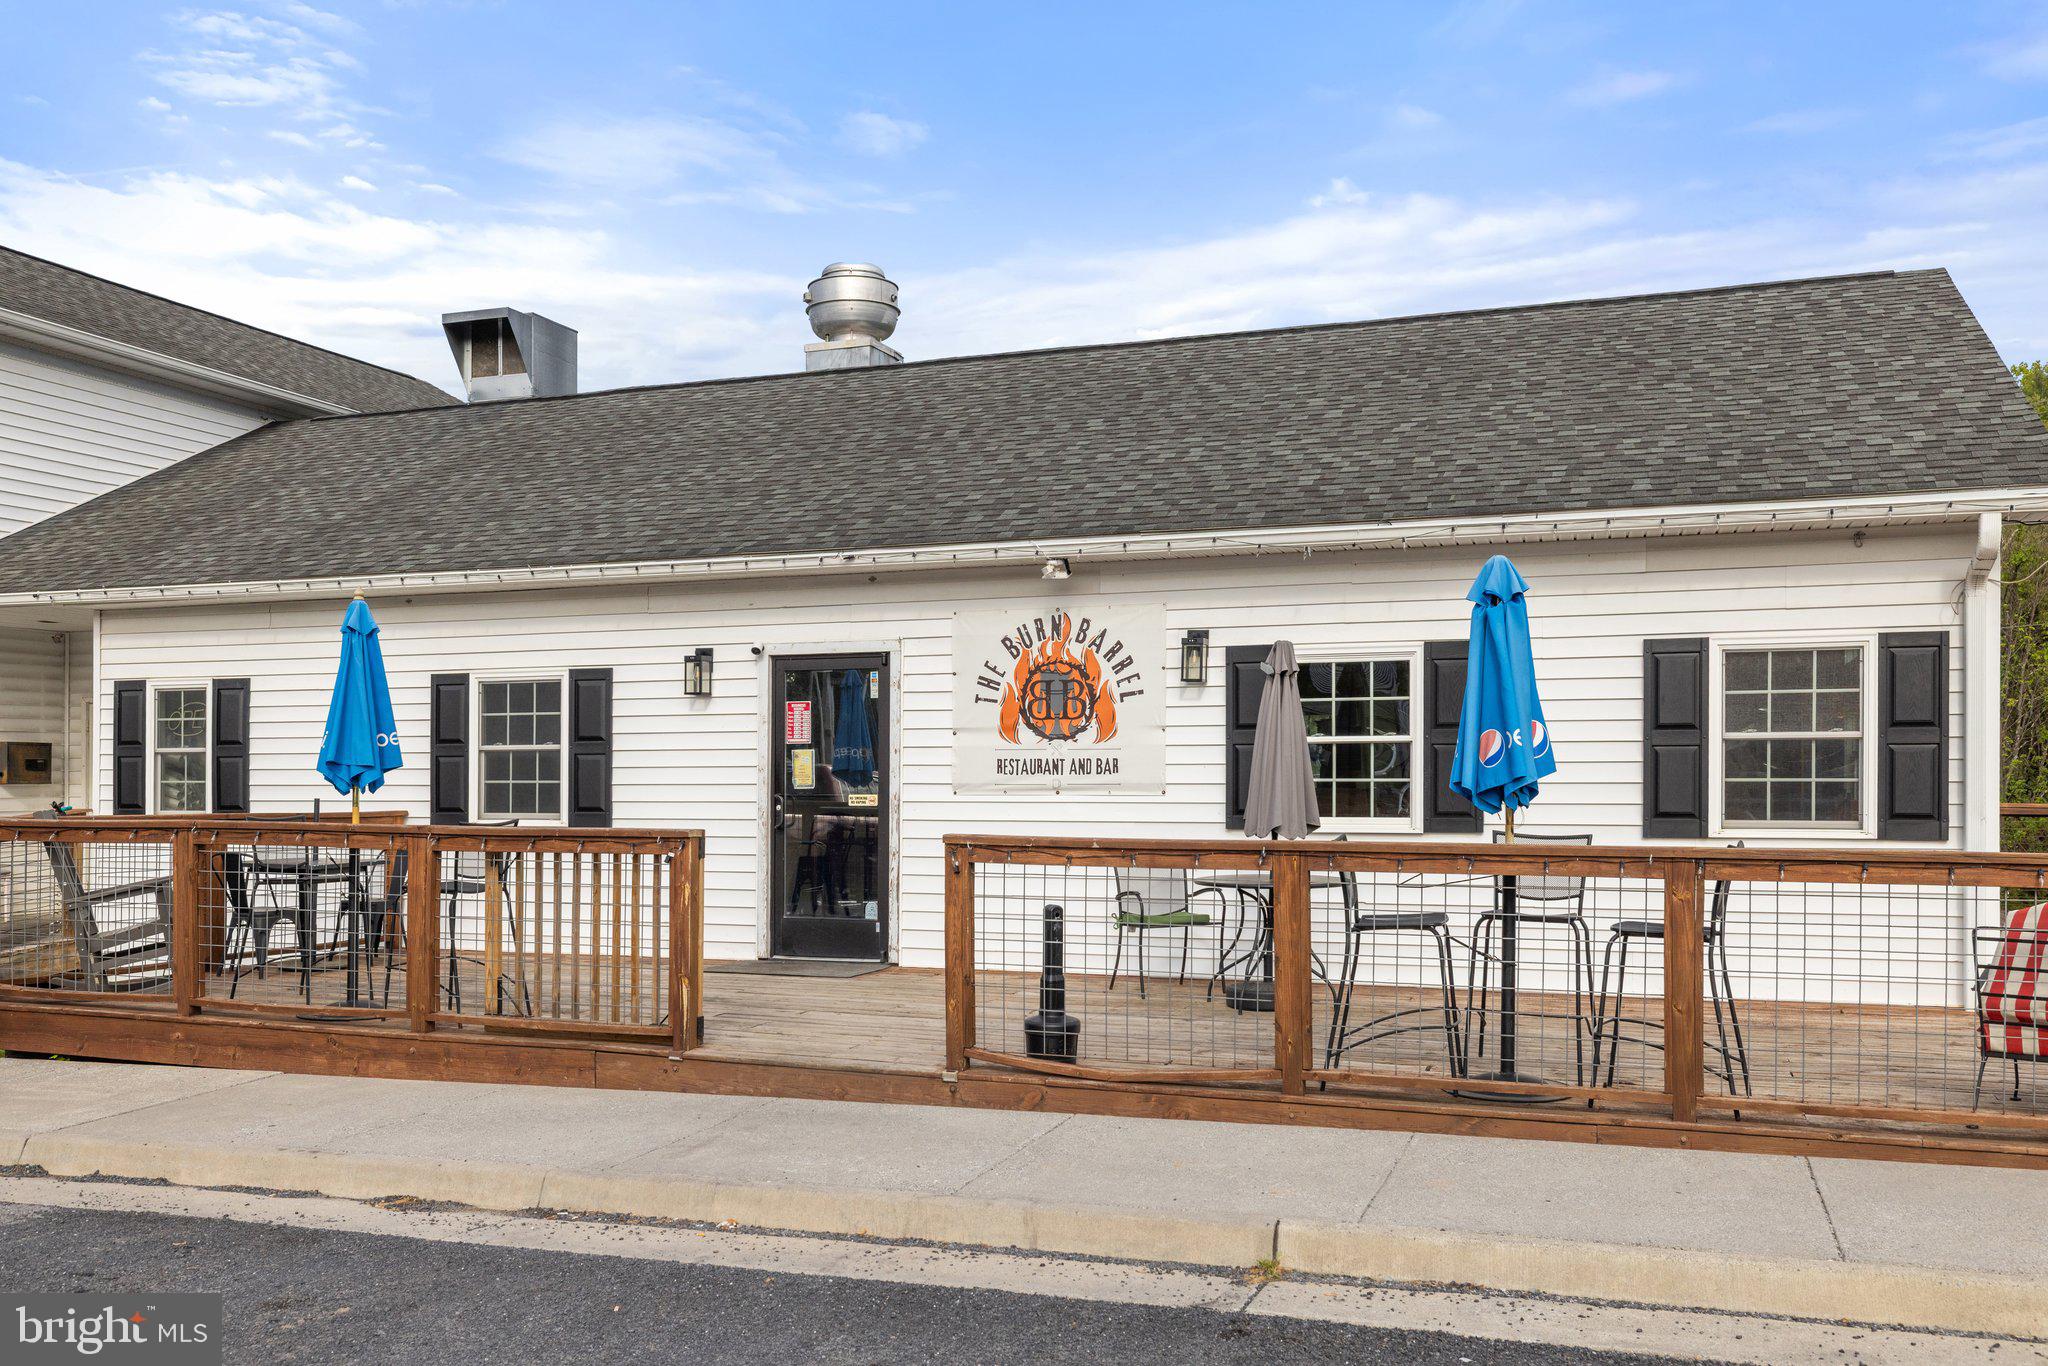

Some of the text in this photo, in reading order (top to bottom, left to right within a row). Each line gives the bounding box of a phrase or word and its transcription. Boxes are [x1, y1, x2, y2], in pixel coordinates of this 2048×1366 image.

[975, 614, 1144, 704] THE BURN BARREL
[996, 758, 1119, 776] RESTAURANT AND BAR
